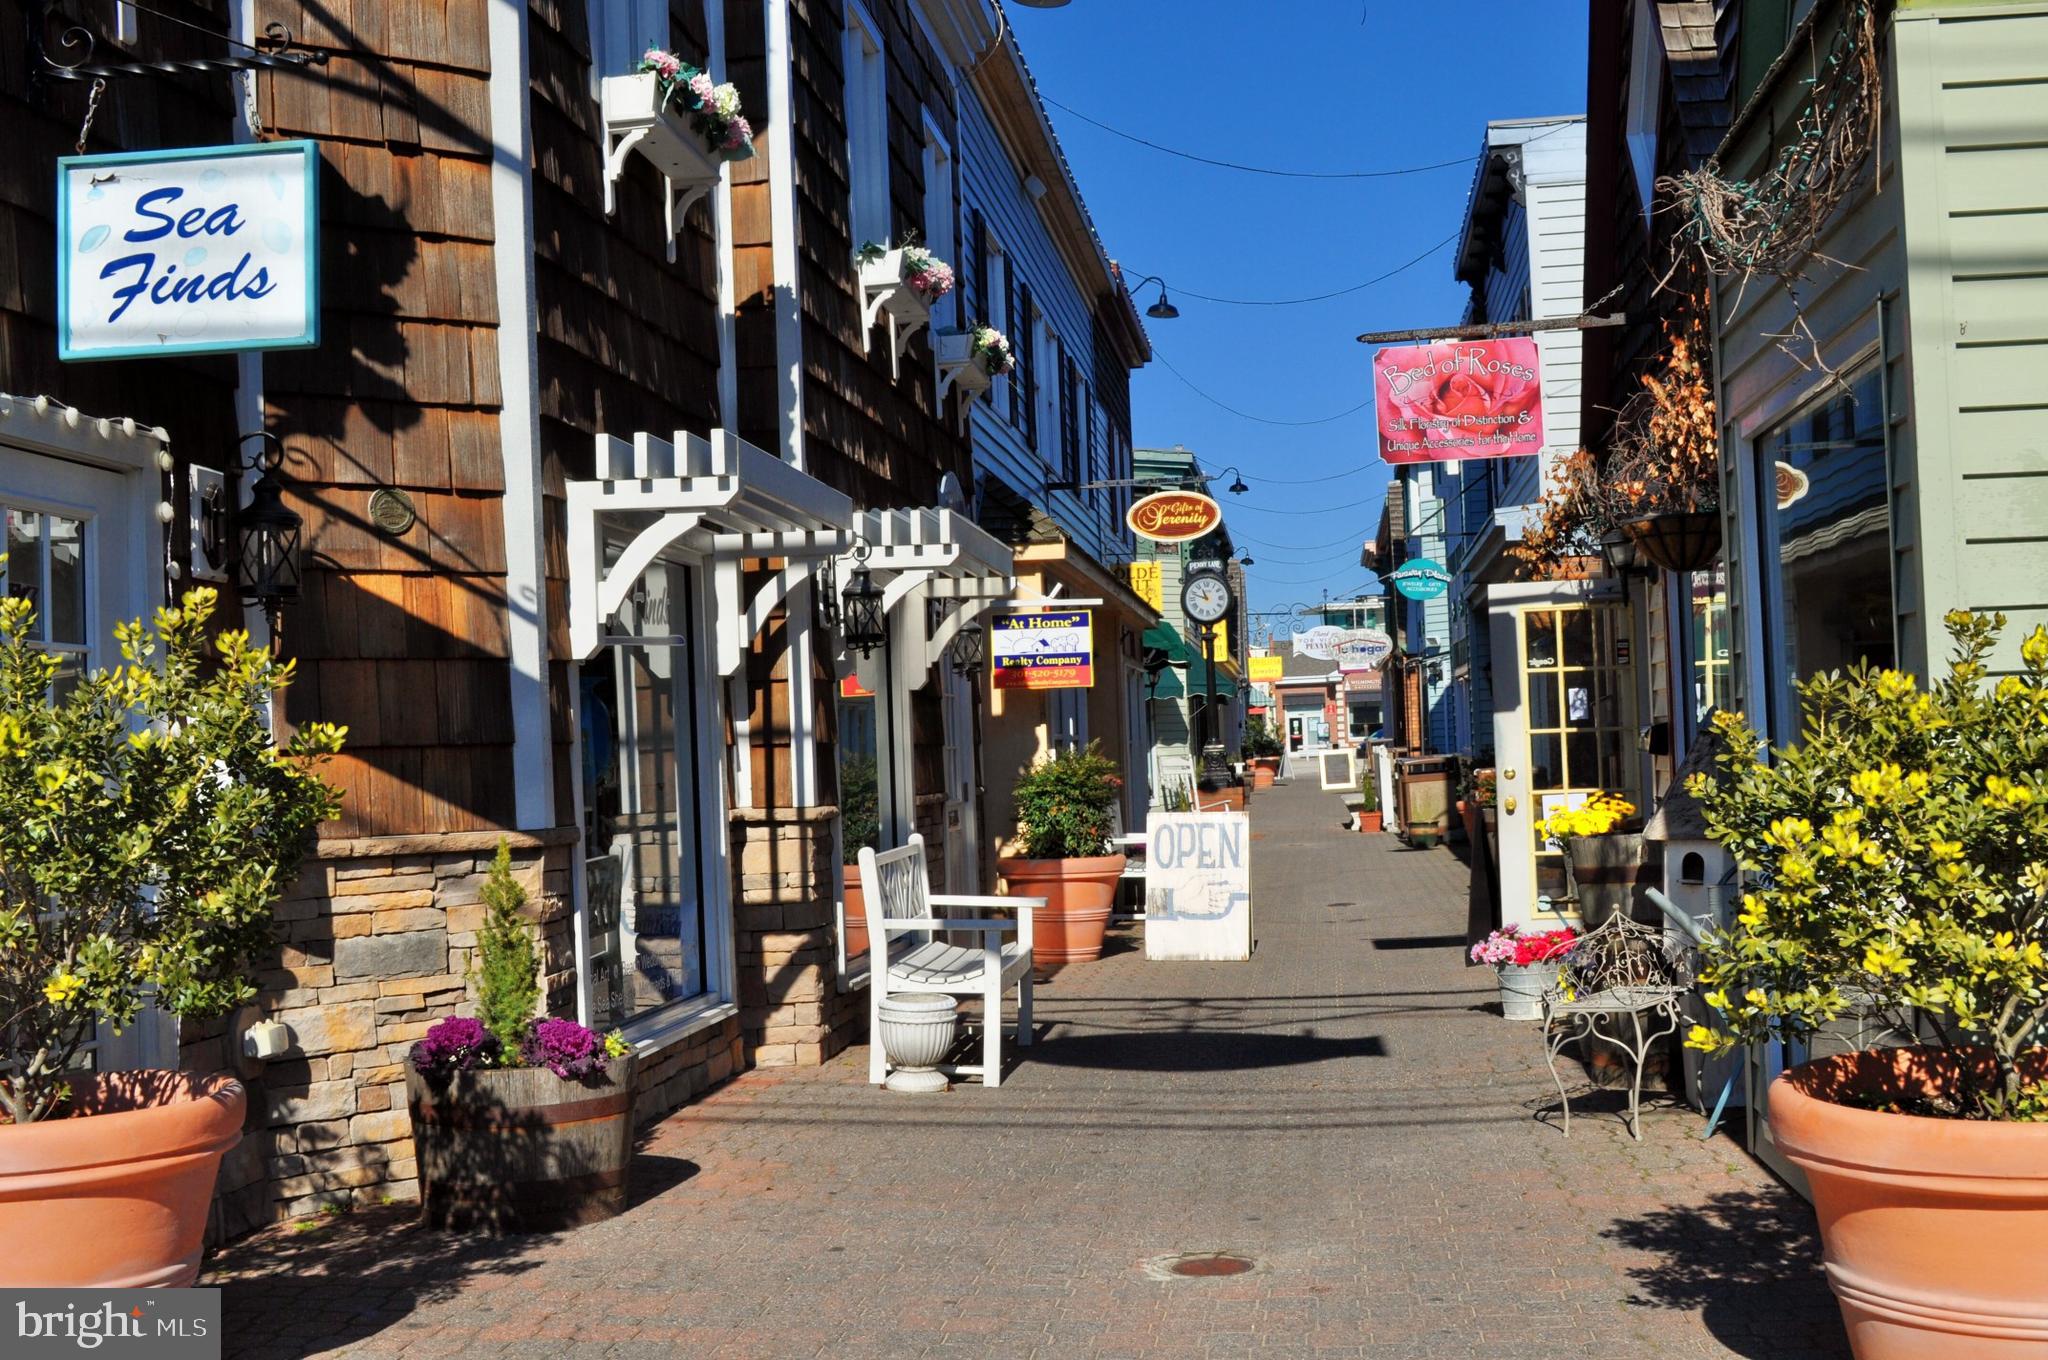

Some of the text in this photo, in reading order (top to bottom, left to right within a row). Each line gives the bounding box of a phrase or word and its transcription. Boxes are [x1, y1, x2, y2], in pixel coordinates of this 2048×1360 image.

[123, 187, 245, 243] Sea
[99, 252, 277, 323] Finds
[1382, 346, 1534, 396] Bed of Roses
[1388, 418, 1407, 432] Silk
[1451, 415, 1463, 427] of
[1463, 414, 1515, 427] Distinction
[1517, 410, 1533, 425] &
[1387, 440, 1420, 455] Unique
[1421, 436, 1474, 451] Accessories
[1477, 432, 1493, 446] for
[1508, 431, 1536, 443] Home
[1137, 502, 1209, 532] Serenity
[1171, 500, 1204, 514] Gifts of
[1189, 560, 1222, 571] PENNY LANE
[1002, 616, 1080, 629] “At Home”
[1351, 645, 1386, 655] hogar
[1002, 656, 1082, 668] Realty Company
[1154, 823, 1243, 869] OPEN
